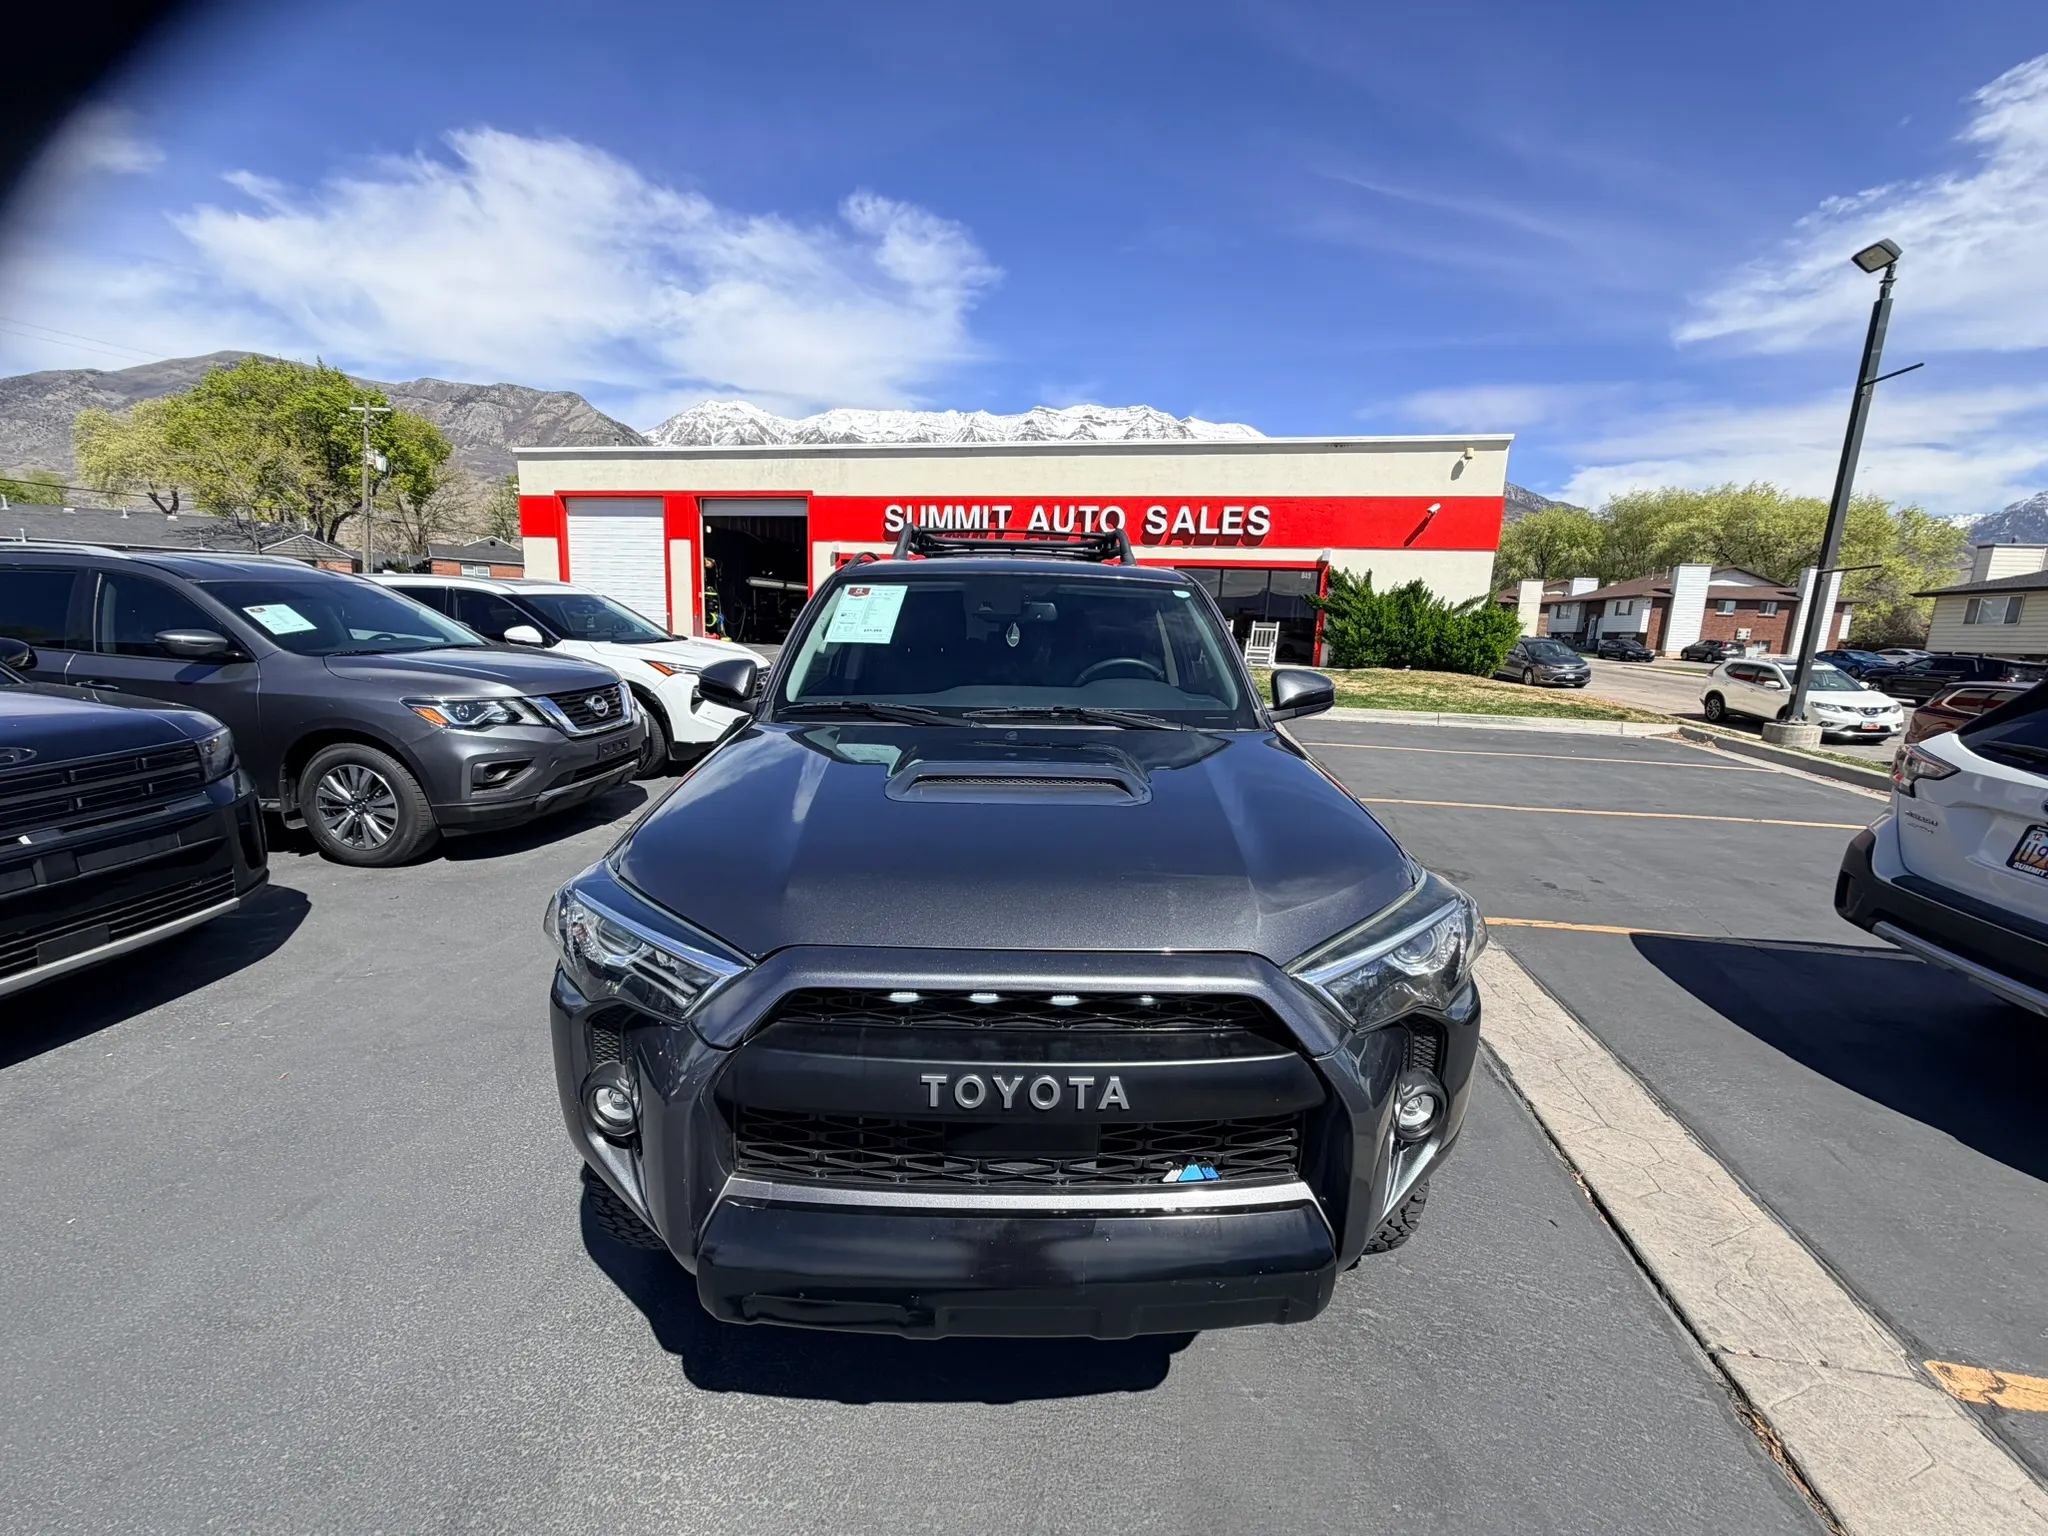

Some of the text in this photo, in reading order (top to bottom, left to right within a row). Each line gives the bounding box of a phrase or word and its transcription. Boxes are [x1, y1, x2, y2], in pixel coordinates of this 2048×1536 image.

[885, 505, 1271, 536] SUMMIT AUTO SALES
[920, 1074, 1130, 1110] TOYOTA
